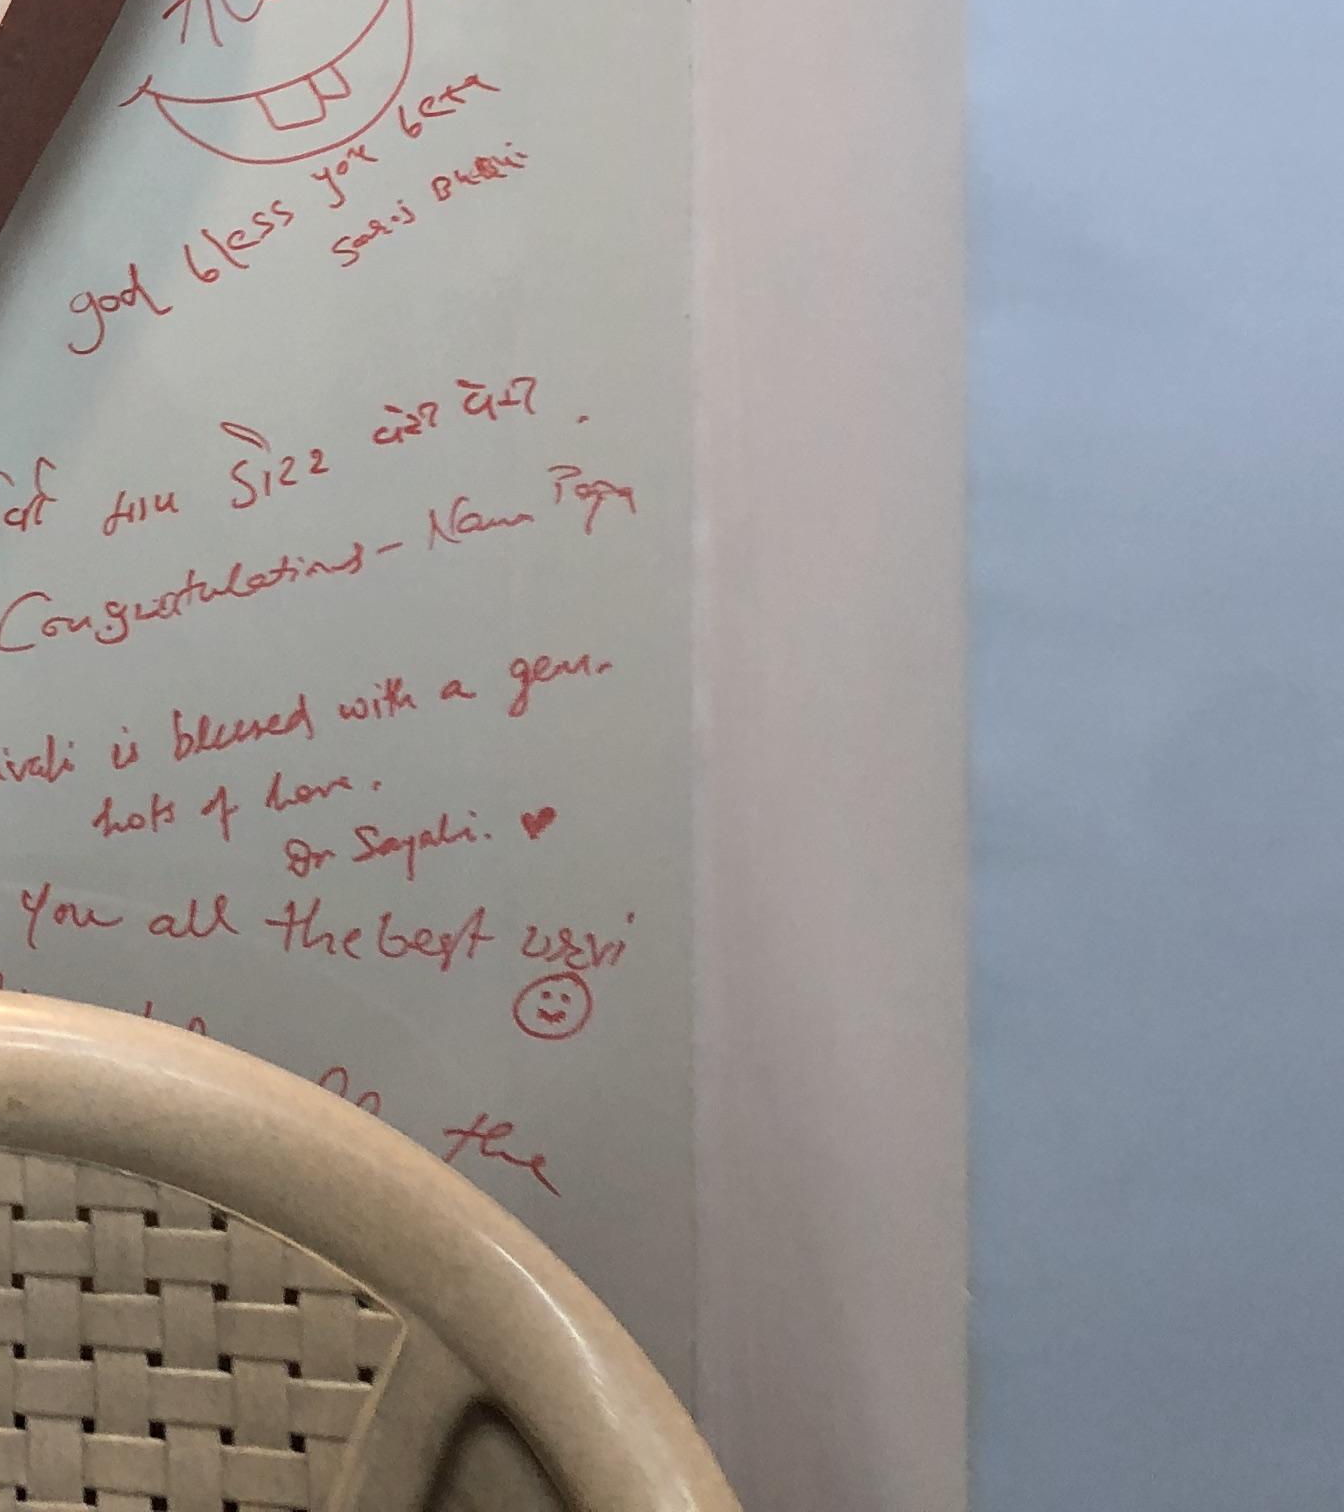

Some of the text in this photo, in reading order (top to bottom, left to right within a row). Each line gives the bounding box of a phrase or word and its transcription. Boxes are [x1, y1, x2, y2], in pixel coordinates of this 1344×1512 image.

[111, 726, 140, 770] is
[339, 677, 420, 725] with
[440, 679, 477, 704] a
[148, 893, 241, 940] all
